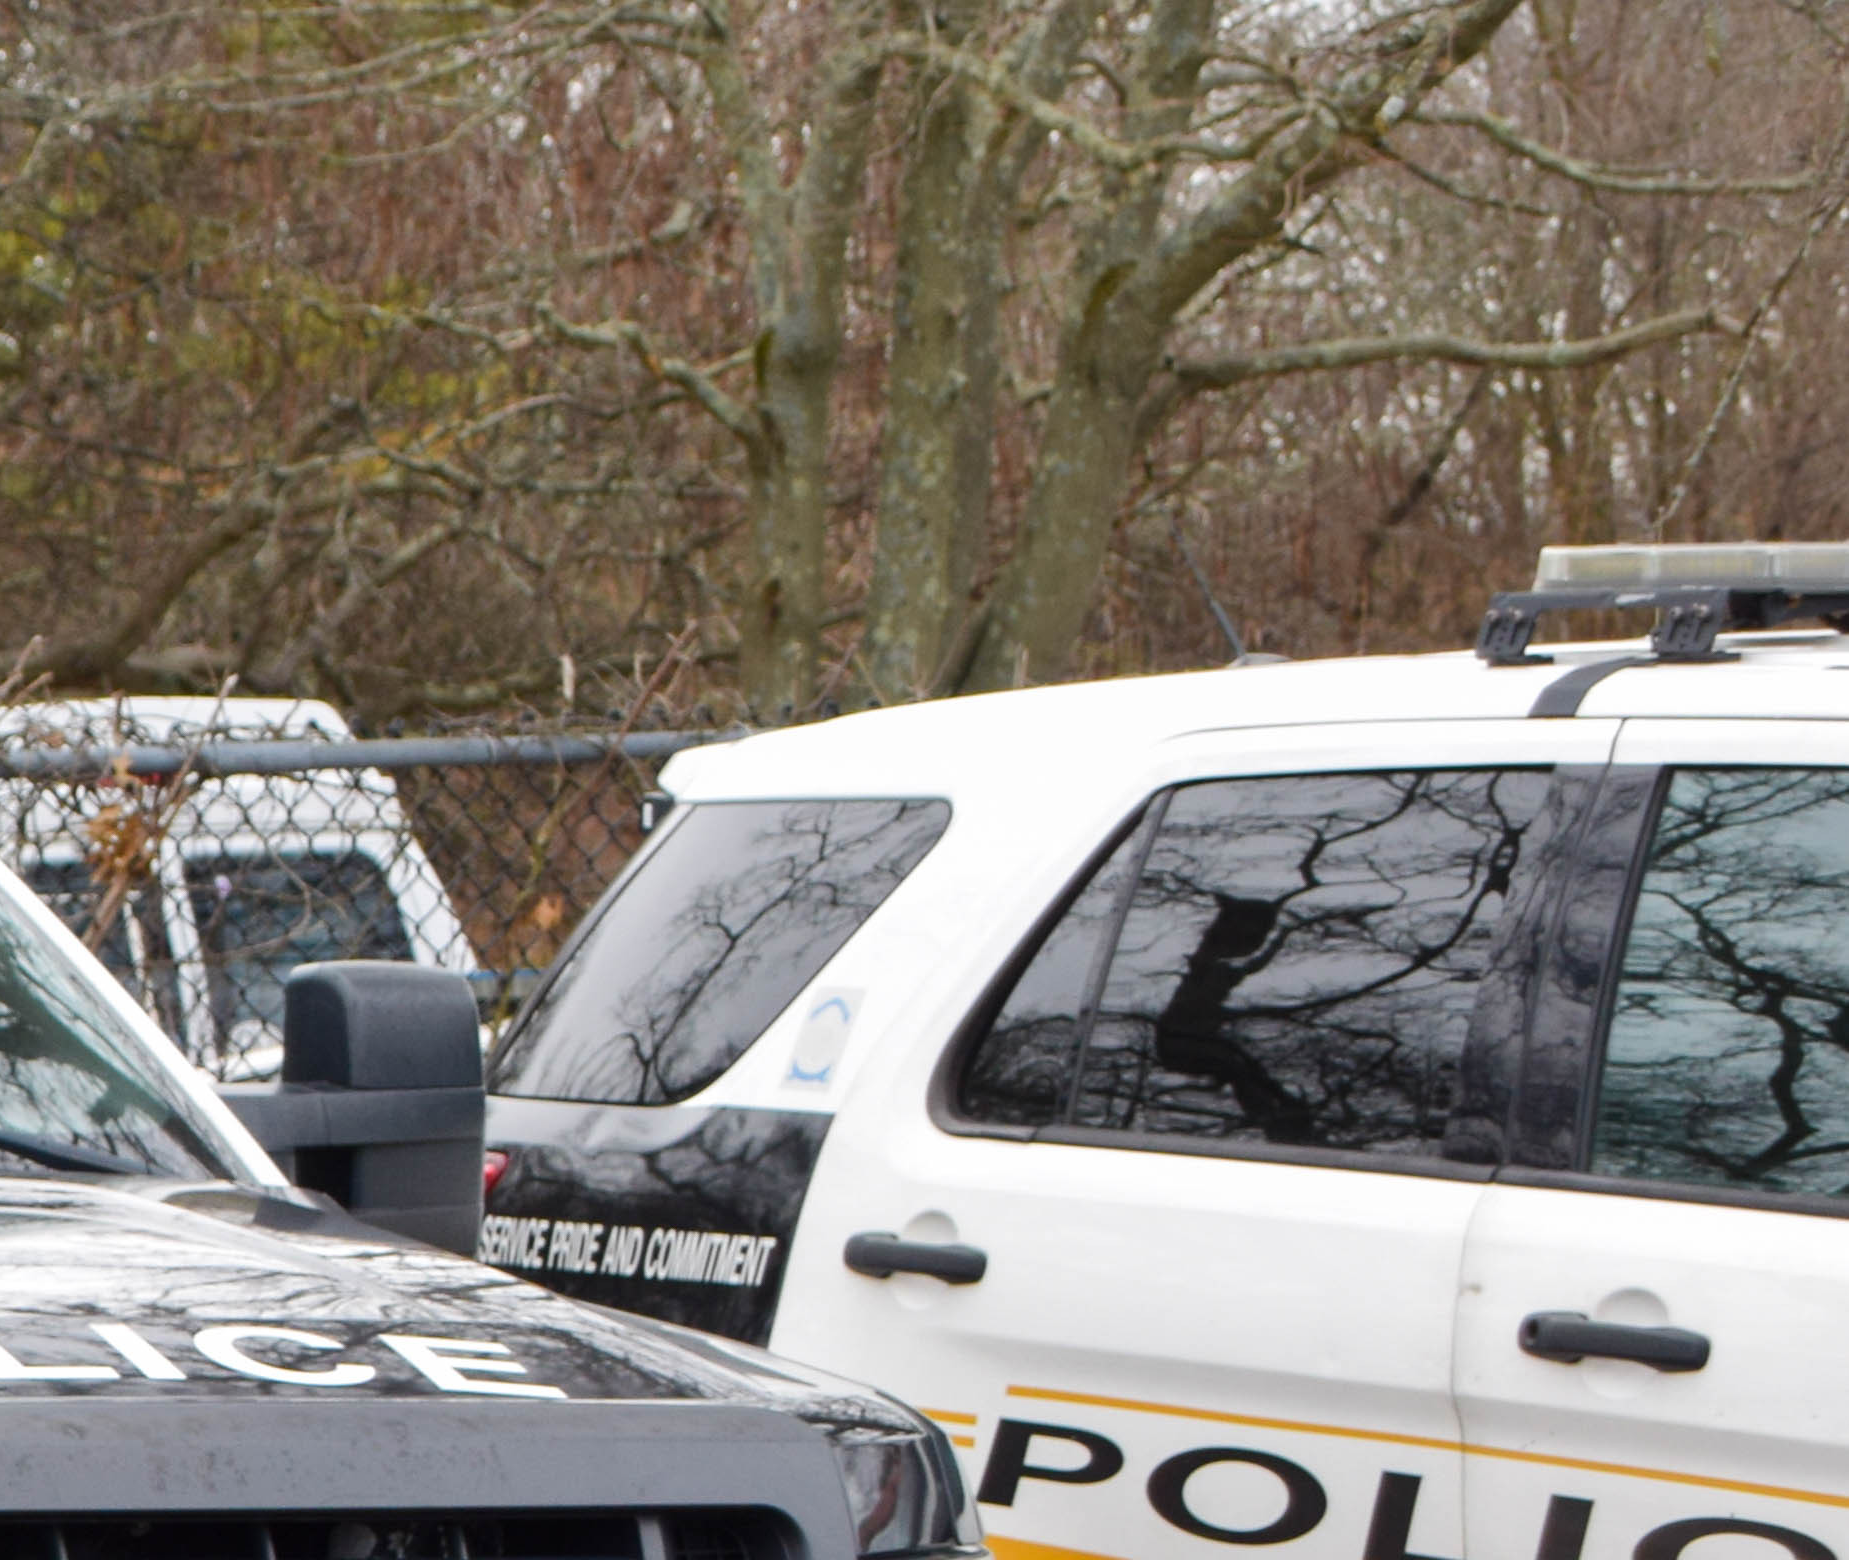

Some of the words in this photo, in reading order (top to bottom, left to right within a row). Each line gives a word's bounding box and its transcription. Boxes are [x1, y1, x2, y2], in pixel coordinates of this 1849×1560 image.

[478, 1214, 549, 1271] SERVICE
[547, 1221, 603, 1273] PRIDE
[601, 1226, 644, 1277] AND
[643, 1227, 778, 1286] COMMITMENT
